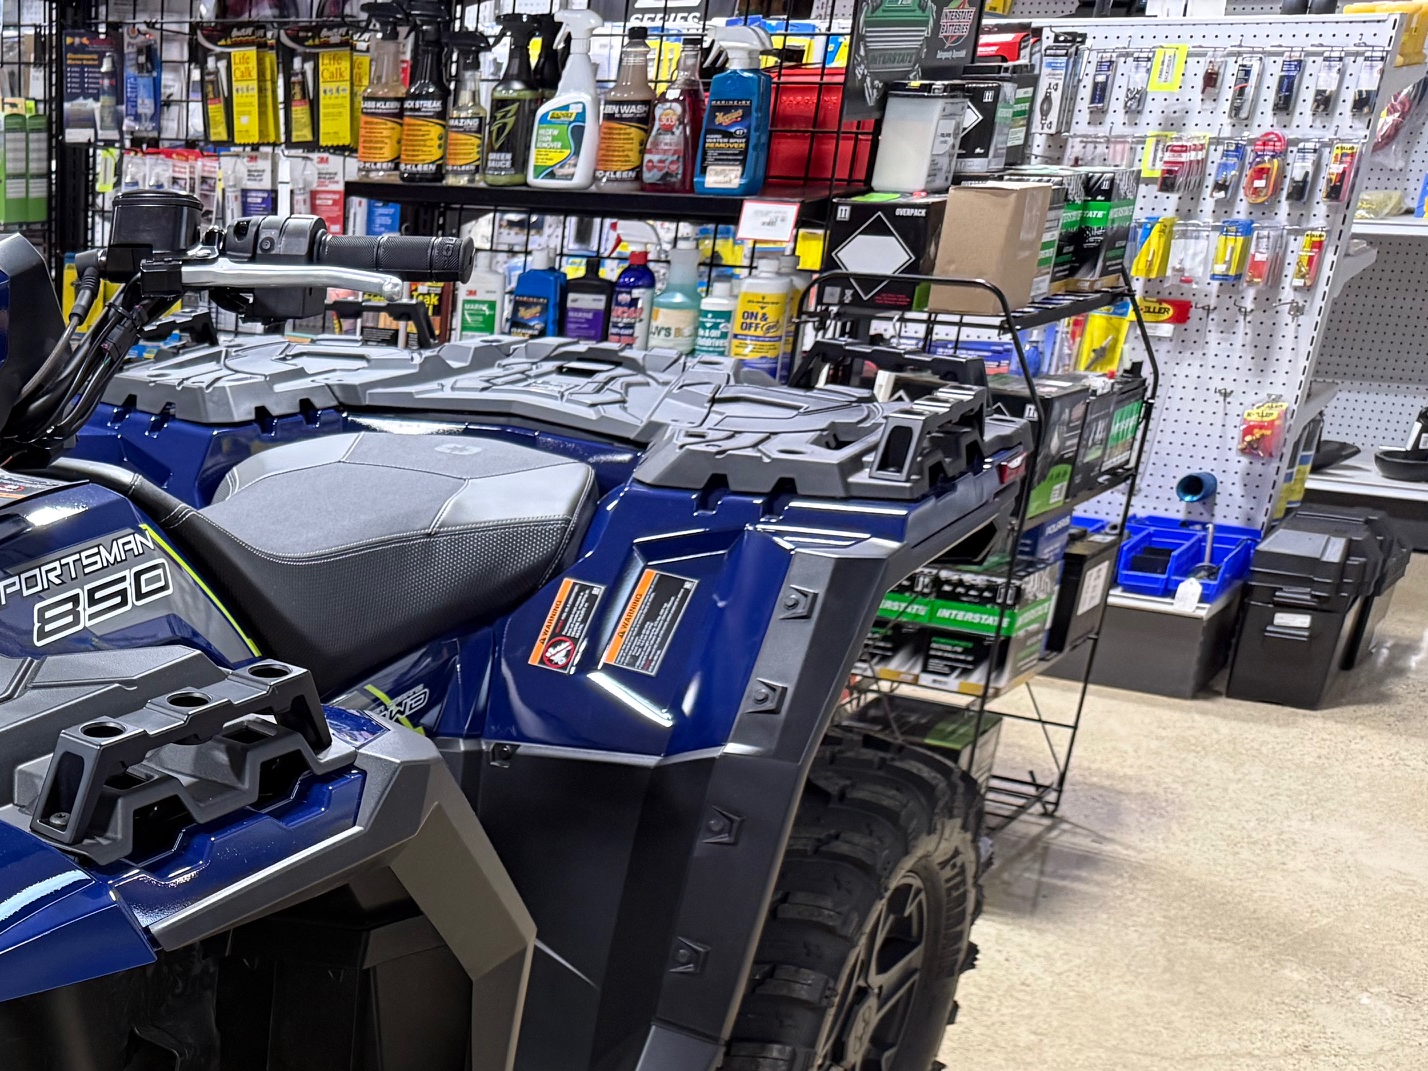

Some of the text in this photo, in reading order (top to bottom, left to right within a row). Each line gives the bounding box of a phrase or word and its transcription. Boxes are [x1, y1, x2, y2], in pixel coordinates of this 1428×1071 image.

[941, 9, 974, 21] INTERSTATE
[940, 22, 970, 35] BATTERIES
[233, 52, 251, 66] Life
[321, 52, 343, 67] Life
[619, 104, 649, 114] WASH
[895, 207, 927, 218] OVERPACK
[412, 291, 440, 307] Teak
[742, 311, 769, 322] ON &
[740, 321, 761, 332] OFF
[32, 557, 174, 648] 850
[541, 599, 562, 636] WARNING
[620, 592, 642, 629] WARNING
[936, 607, 1011, 628] INTERSTATE
